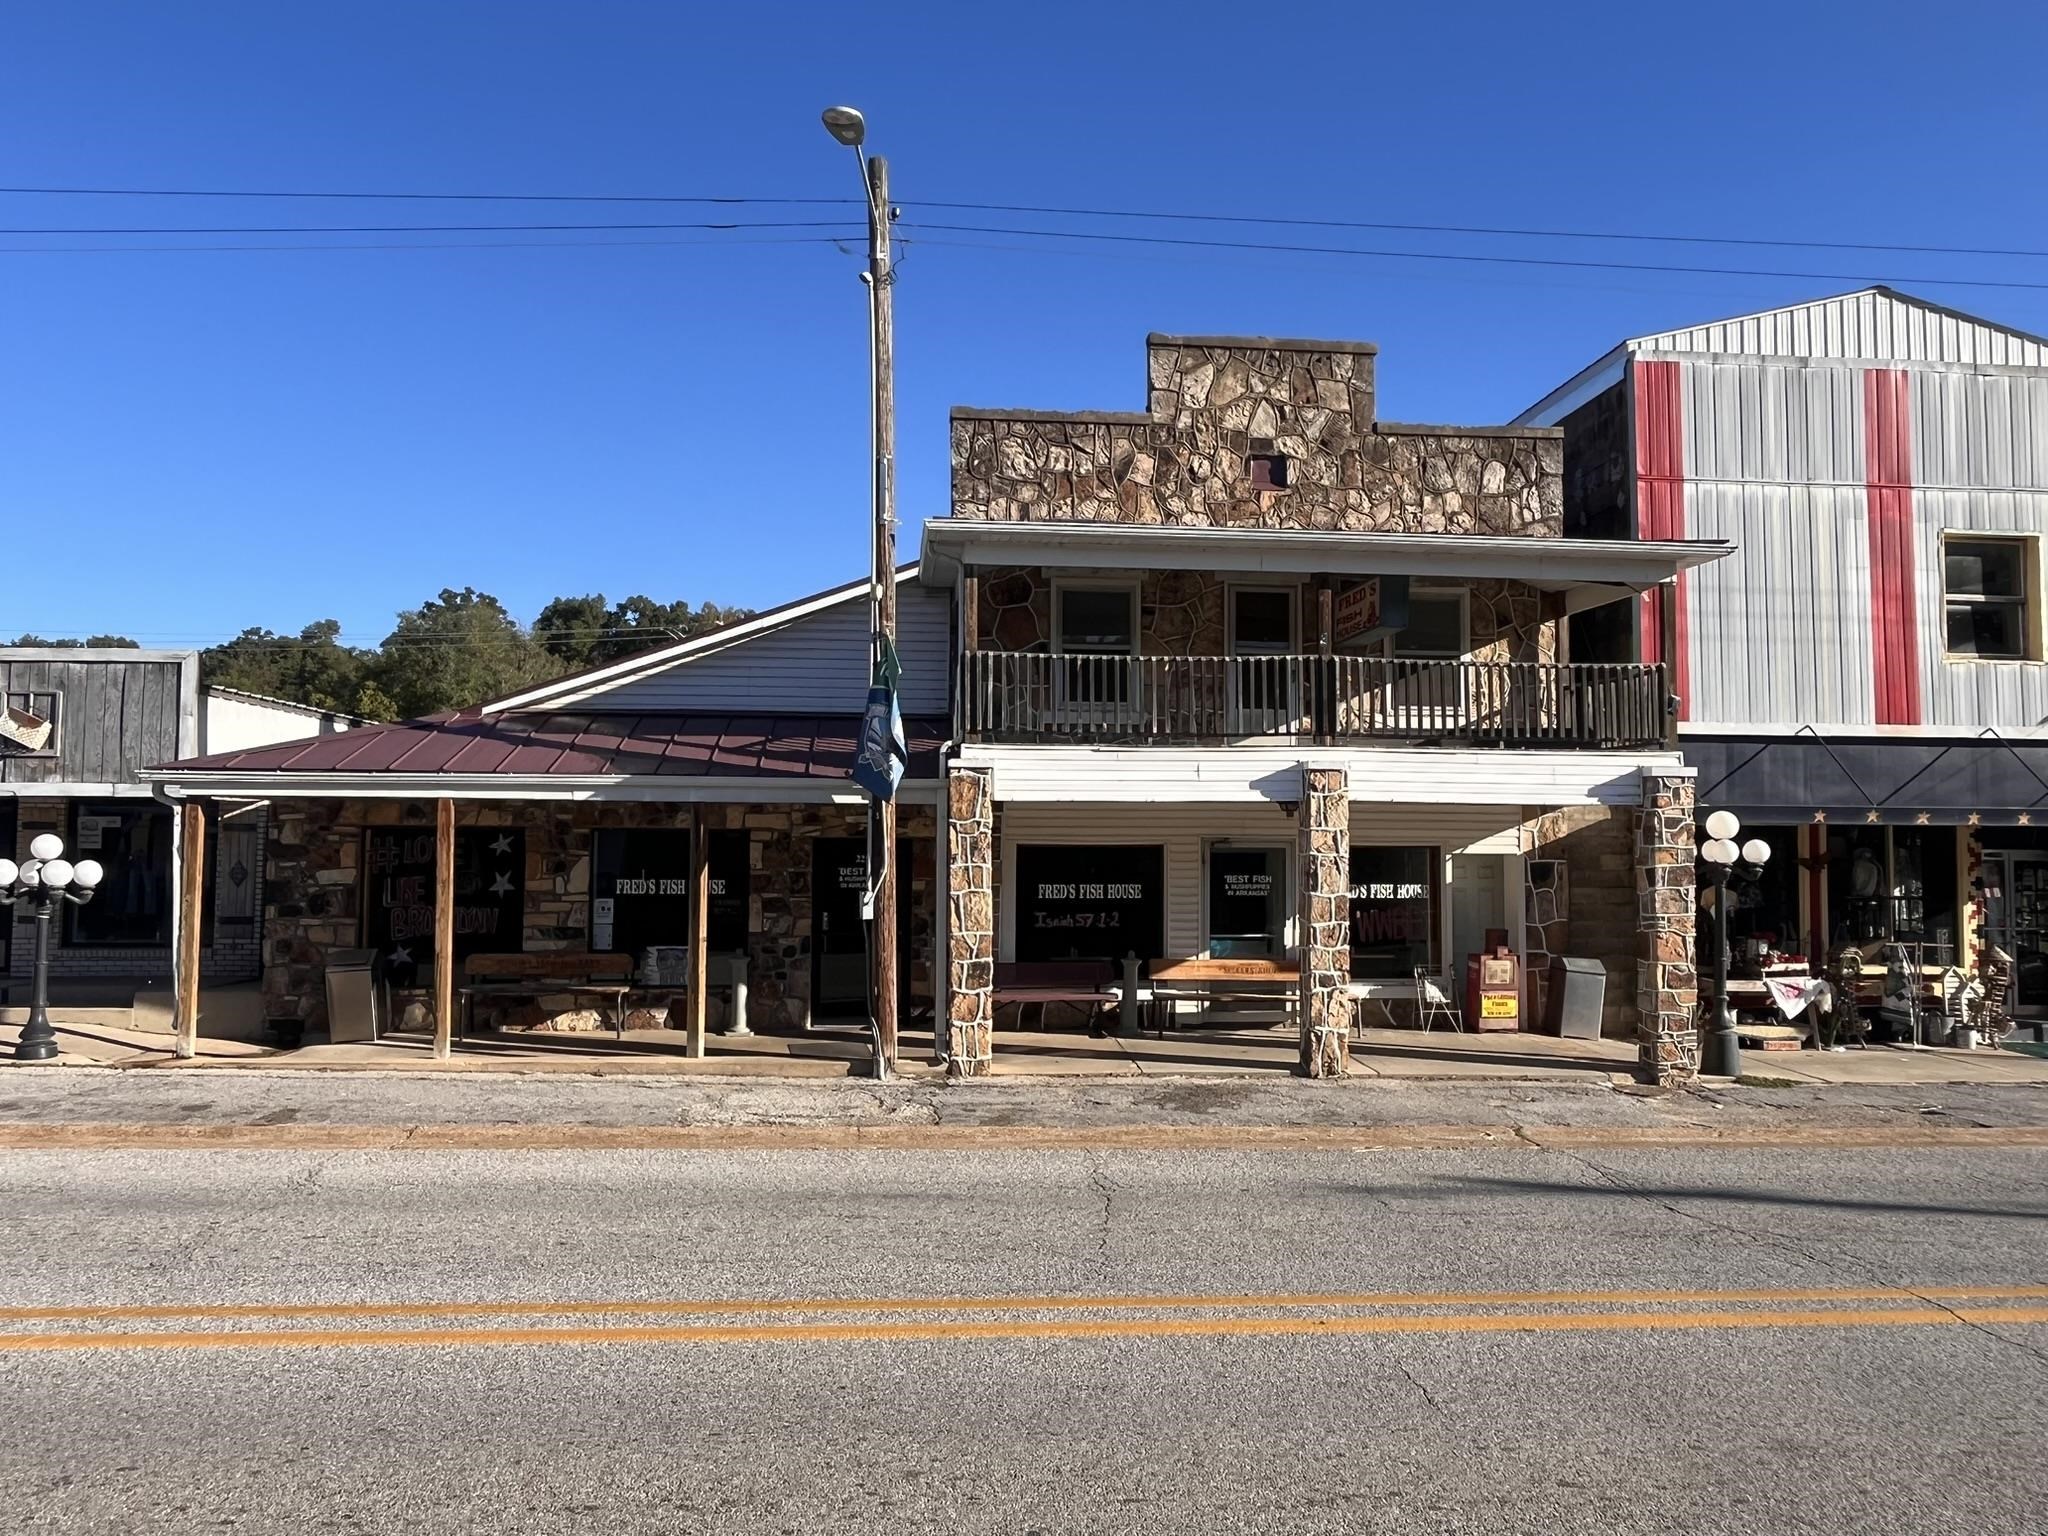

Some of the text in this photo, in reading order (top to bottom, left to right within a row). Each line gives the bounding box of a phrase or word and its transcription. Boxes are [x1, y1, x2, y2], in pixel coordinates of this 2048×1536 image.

[1339, 582, 1376, 612] FRED'S
[1337, 607, 1362, 626] FISH
[616, 879, 686, 894] FRED'S FISH
[1252, 874, 1272, 883] FISH
[1038, 883, 1142, 899] FRED'S FISH HOUSE
[1370, 884, 1394, 899] FISH
[1396, 884, 1430, 899] HOUSE
[1033, 911, 1074, 928] Isaiah
